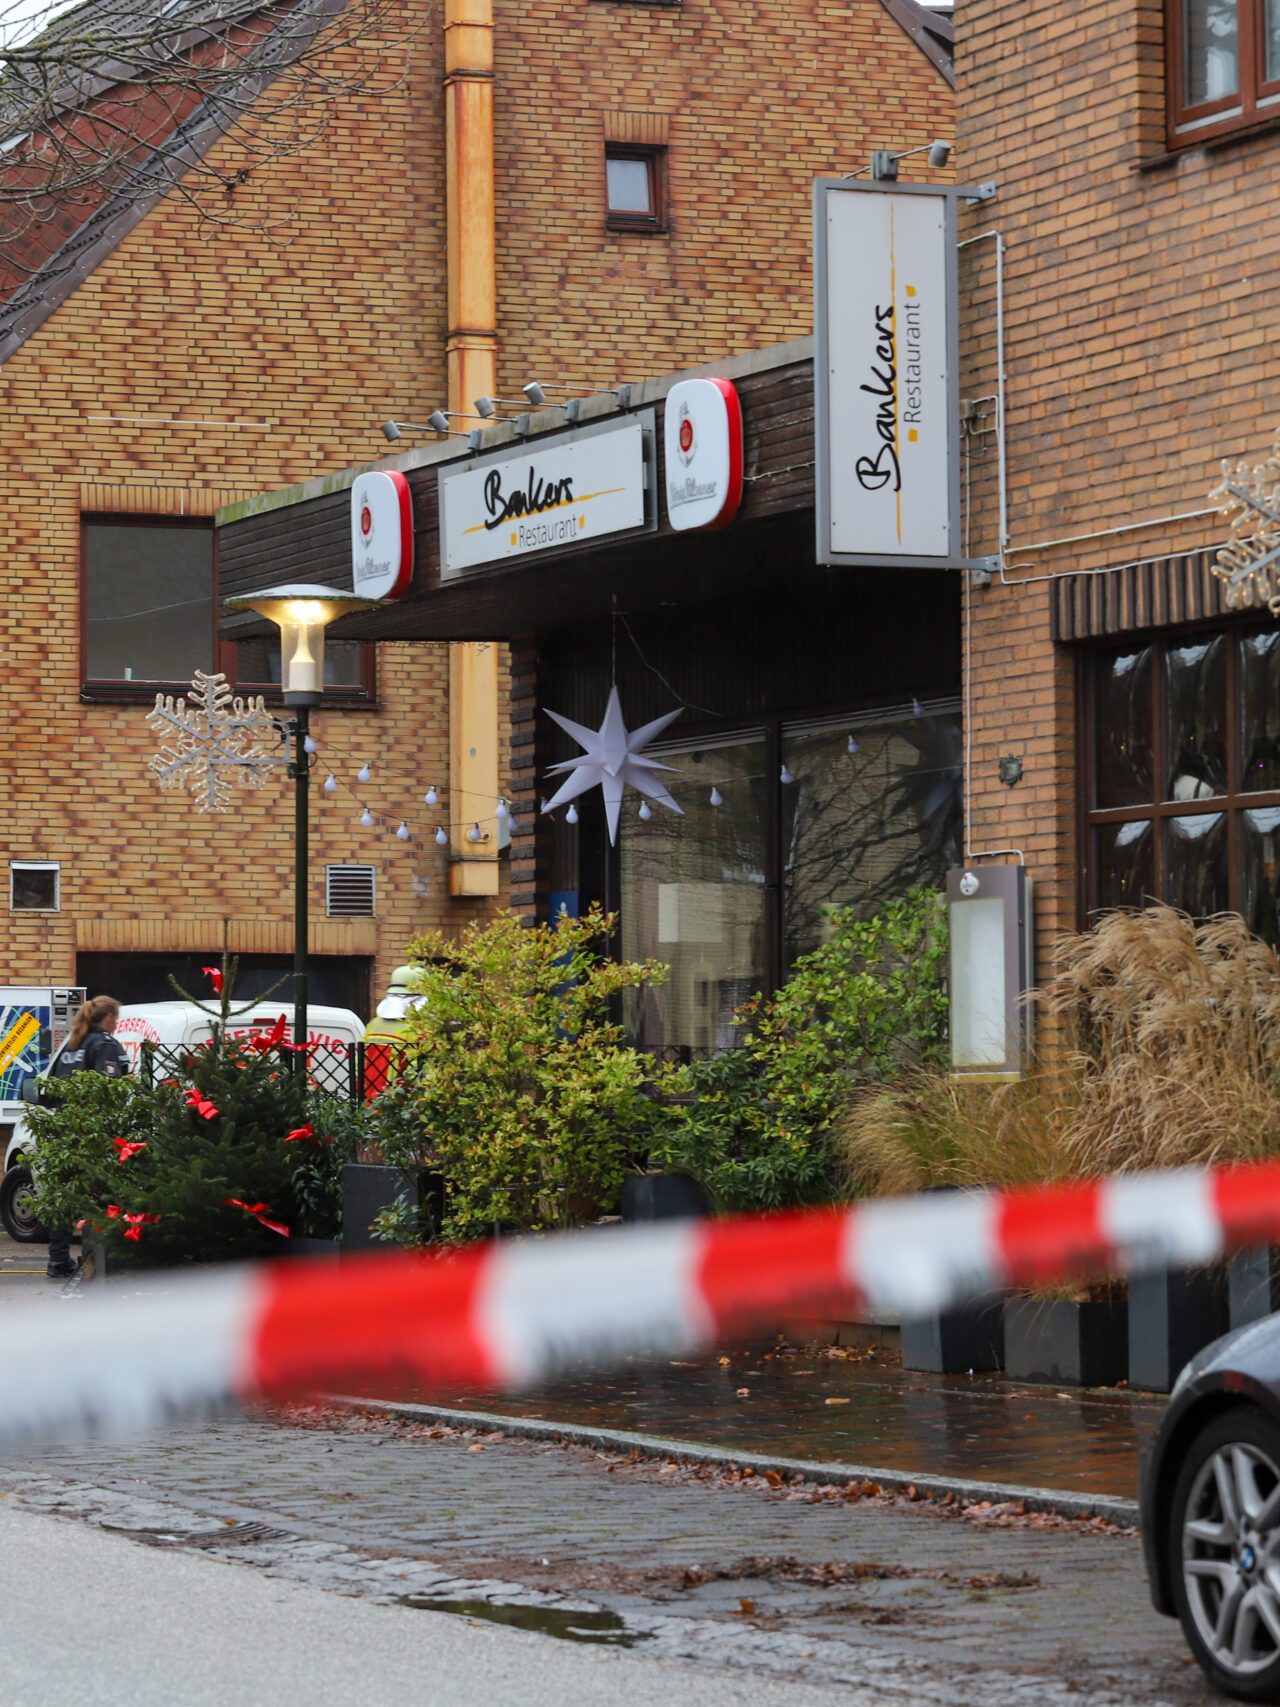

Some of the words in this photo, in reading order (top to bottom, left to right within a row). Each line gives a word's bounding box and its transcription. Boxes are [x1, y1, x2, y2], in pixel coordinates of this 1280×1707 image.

[855, 304, 901, 492] Bankers
[903, 302, 921, 424] Restaurant
[484, 466, 574, 530] Bankers
[519, 515, 577, 548] Restaurant
